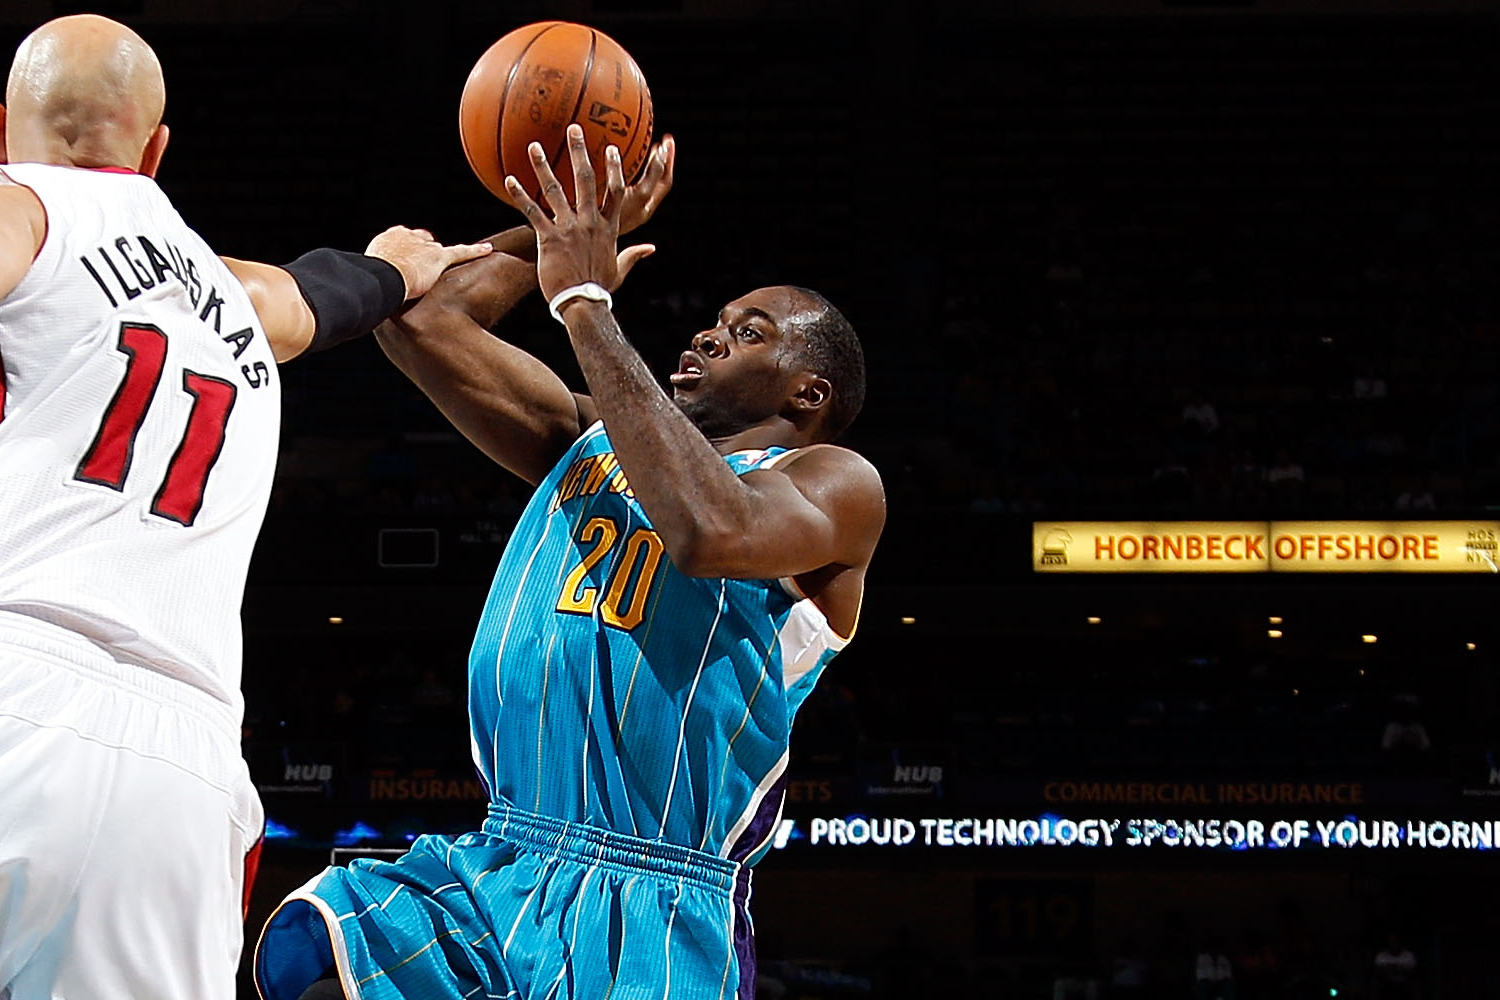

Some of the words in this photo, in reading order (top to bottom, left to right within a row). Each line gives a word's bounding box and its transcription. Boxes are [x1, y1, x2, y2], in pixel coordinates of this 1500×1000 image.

[79, 235, 269, 389] ILGAUSKAS
[73, 320, 238, 527] 11
[1095, 535, 1265, 561] HORNBECK
[1275, 534, 1439, 561] OFFSHORE
[555, 516, 666, 635] 20
[283, 763, 333, 781] HUB
[893, 765, 944, 782] HUB
[1043, 780, 1212, 805] COMMERCIAL
[1218, 782, 1364, 805] INSURANCE
[810, 817, 916, 847] PROUD
[920, 817, 1121, 847] TECHNOLOGY
[1125, 818, 1265, 848] SPONSOR
[1269, 819, 1311, 848] OF
[1314, 819, 1400, 848] YOUR
